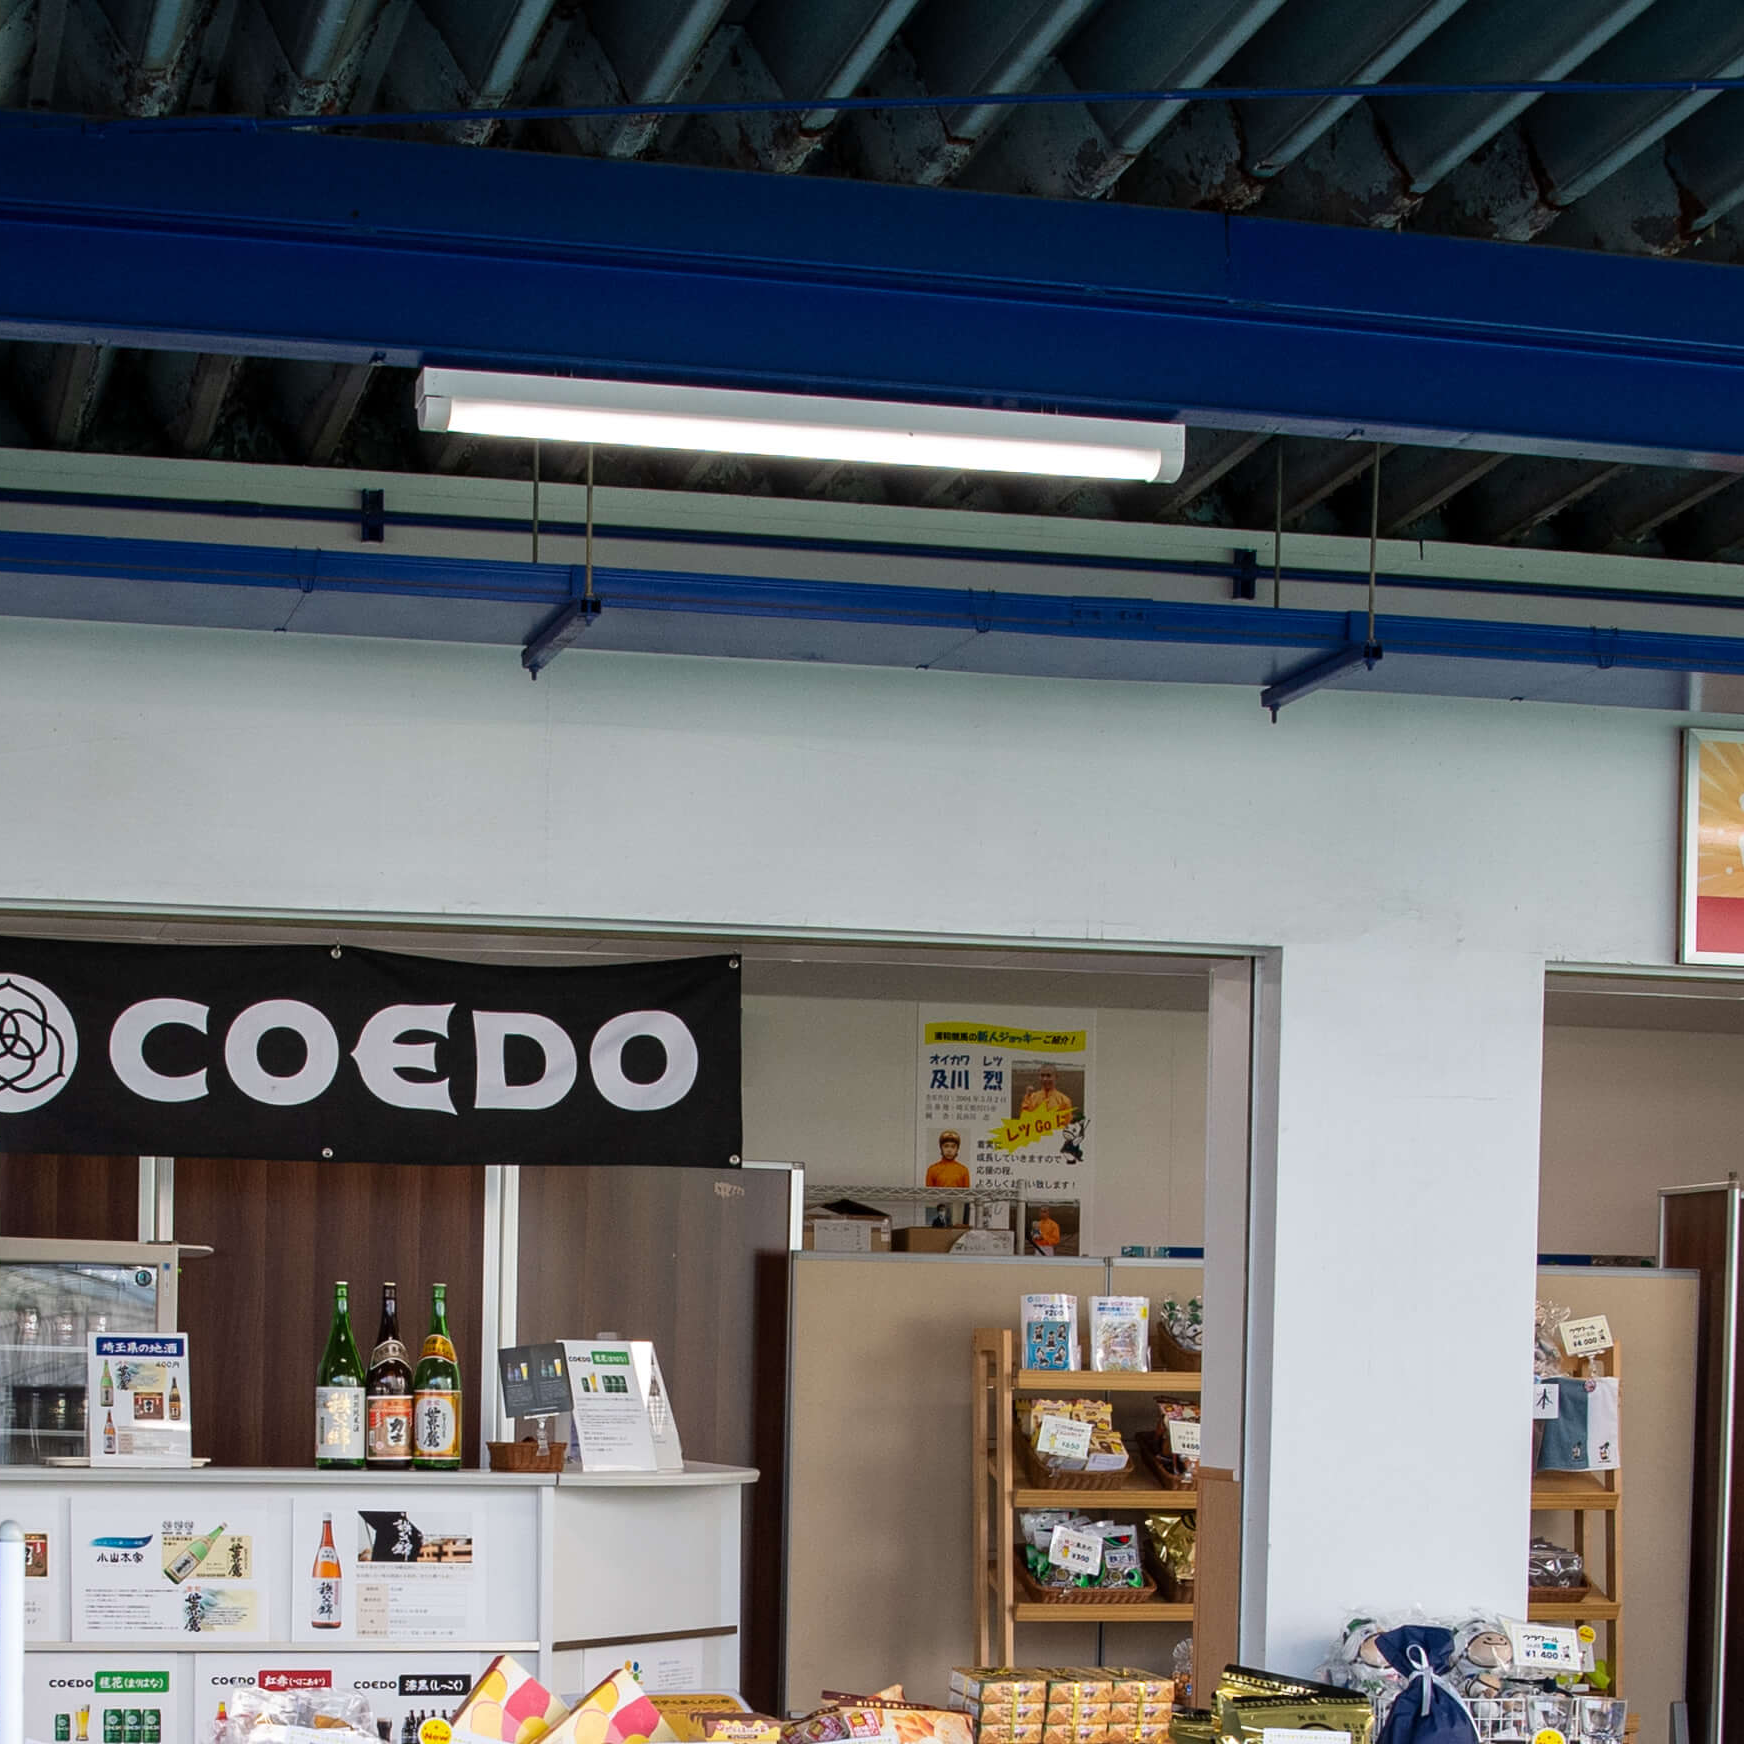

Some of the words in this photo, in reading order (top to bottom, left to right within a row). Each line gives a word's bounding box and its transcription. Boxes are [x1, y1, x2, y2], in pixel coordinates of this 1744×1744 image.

[108, 997, 699, 1115] COEDO
[929, 1054, 970, 1066] オイカワ
[983, 1055, 1003, 1066] レツ
[930, 1069, 970, 1090] 及川
[983, 1070, 1003, 1091] 烈
[102, 1341, 177, 1354] 埼玉県の地酒
[97, 1552, 144, 1564] 小山本家
[49, 1679, 94, 1688] COEDO
[353, 1681, 397, 1689] COEDO
[423, 1731, 450, 1744] New
